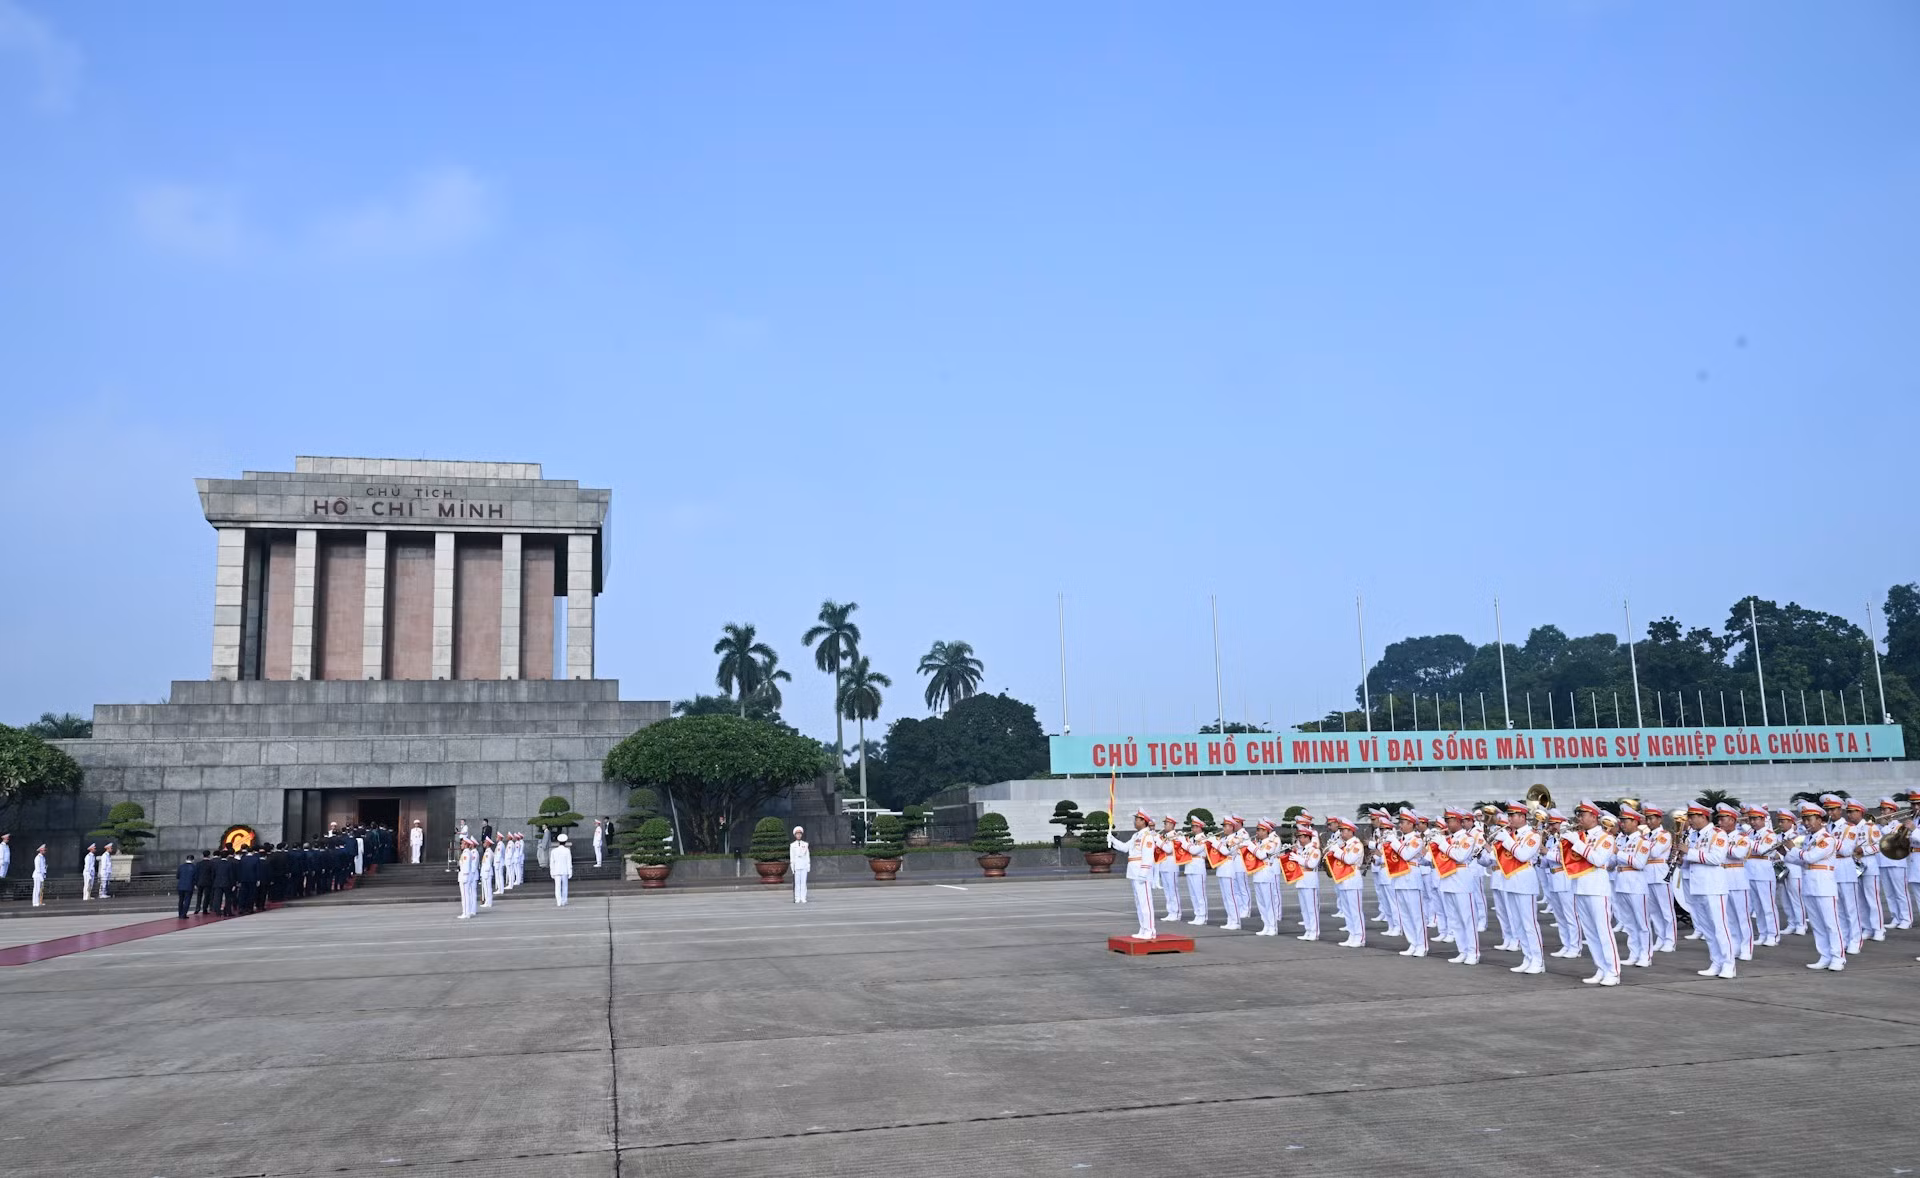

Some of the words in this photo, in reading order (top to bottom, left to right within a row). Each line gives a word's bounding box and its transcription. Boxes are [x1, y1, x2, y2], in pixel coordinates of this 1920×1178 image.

[366, 484, 400, 497] CHỦ
[414, 485, 452, 501] TỊCH
[1093, 736, 1138, 767] CHỦ
[1147, 742, 1199, 770] TỊCH
[1208, 734, 1237, 765] HỒ
[1247, 736, 1283, 764] CHÍ
[1293, 740, 1350, 763] MINH
[1359, 736, 1379, 762] VĨ
[1388, 739, 1423, 765] ĐẠI
[1432, 731, 1488, 761] SỐNG
[1496, 734, 1535, 760] MÃI
[1542, 736, 1608, 759] TRONG
[1615, 732, 1641, 761] SỰ
[1647, 730, 1717, 759] NGHIỆP
[1724, 727, 1762, 755] CỦA
[1768, 729, 1829, 755] CHÚNG
[1834, 732, 1860, 753] TA
